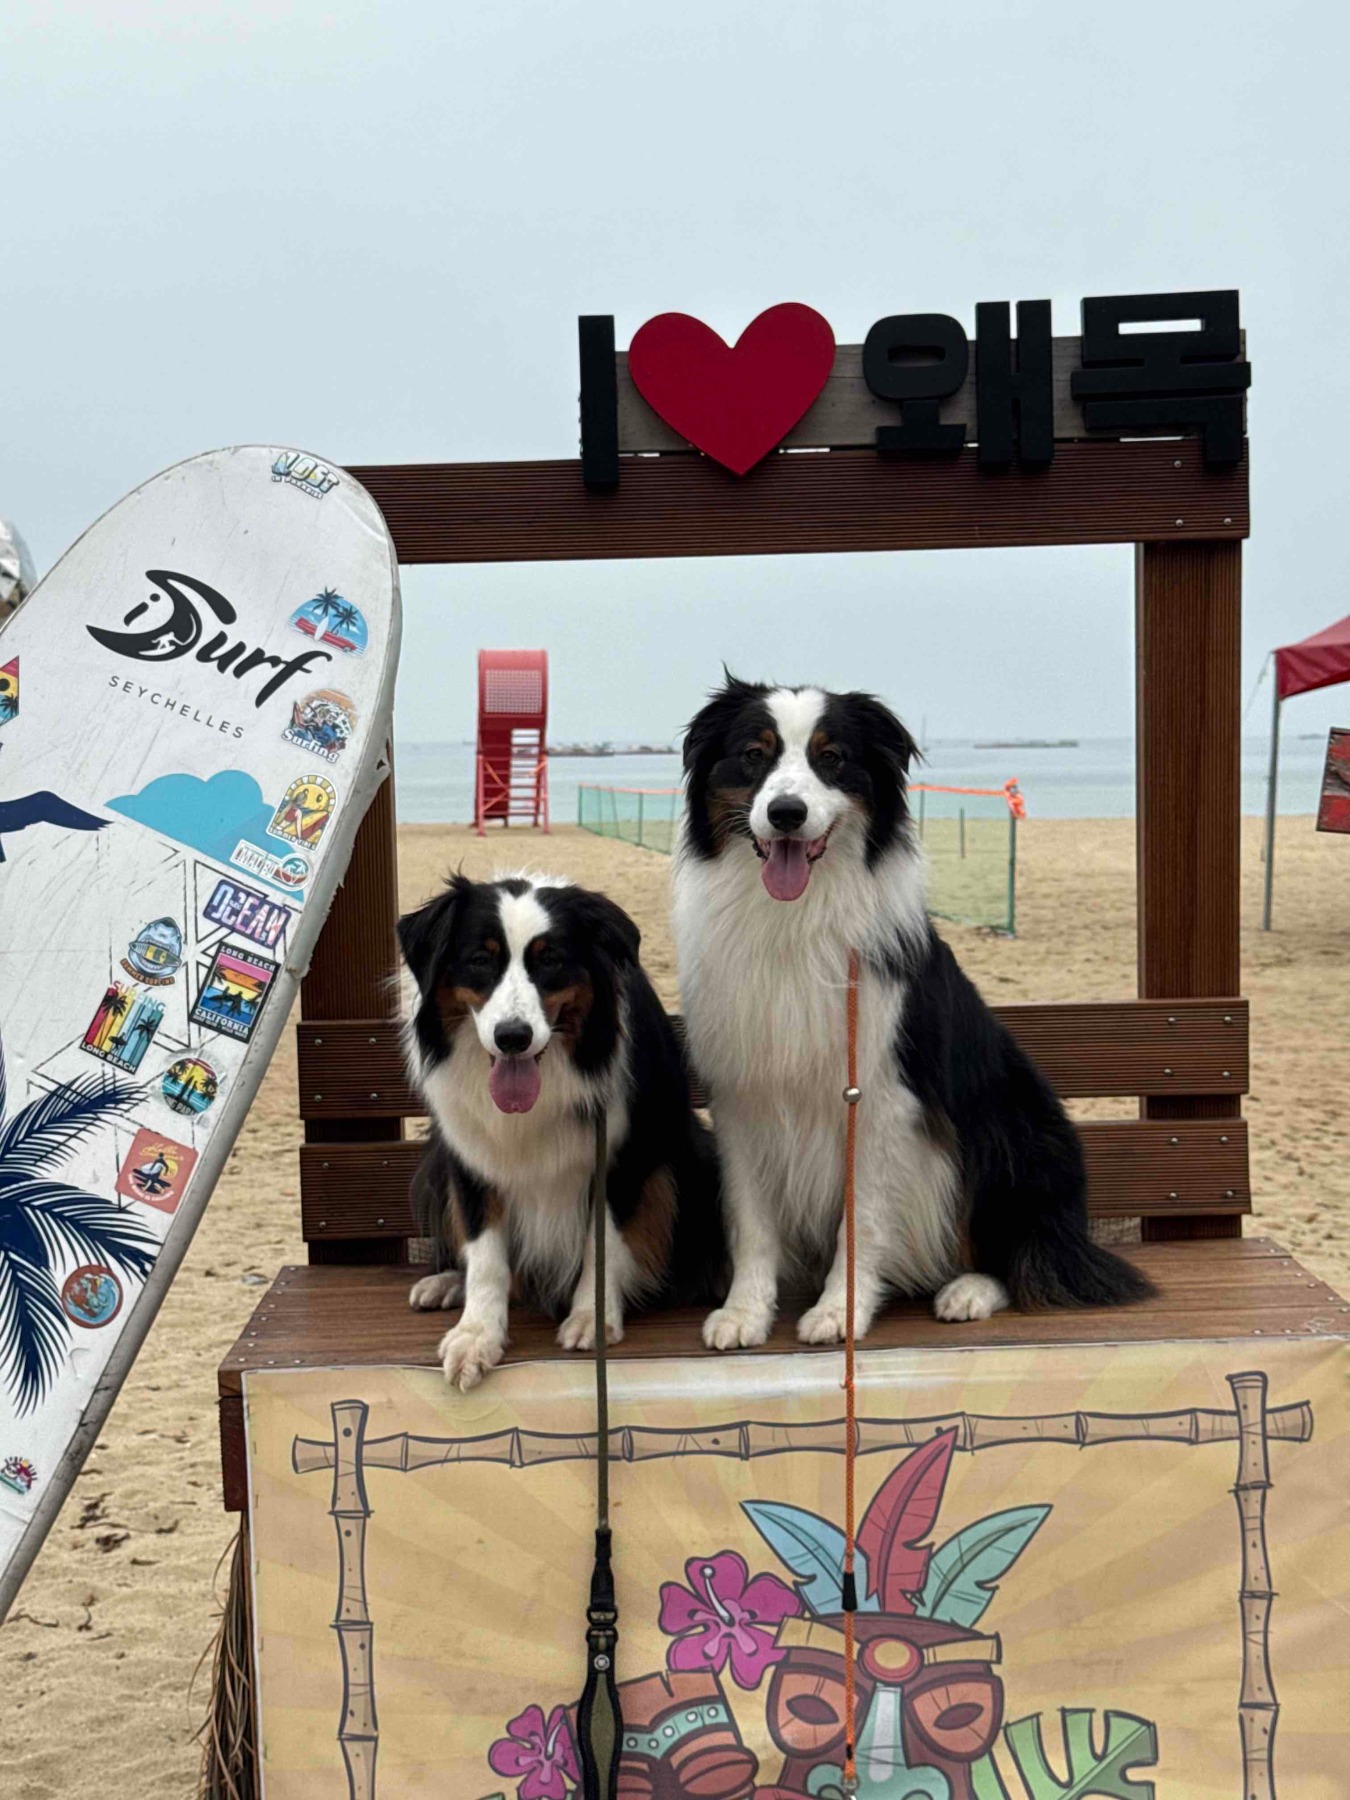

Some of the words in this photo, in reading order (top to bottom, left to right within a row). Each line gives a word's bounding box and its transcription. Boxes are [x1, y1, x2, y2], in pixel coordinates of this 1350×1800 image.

[578, 315, 619, 491] I
[863, 290, 1251, 468] 왜목
[109, 675, 245, 739] SEYCHELLES
[281, 728, 340, 764] Surfing
[211, 884, 288, 946] OCEAN
[220, 945, 245, 960] LONG
[246, 955, 276, 973] BEACH
[113, 980, 166, 1012] SURFING
[194, 1008, 249, 1036] CALIFORNIA
[81, 1042, 106, 1058] LONG
[106, 1054, 136, 1073] BEACH
